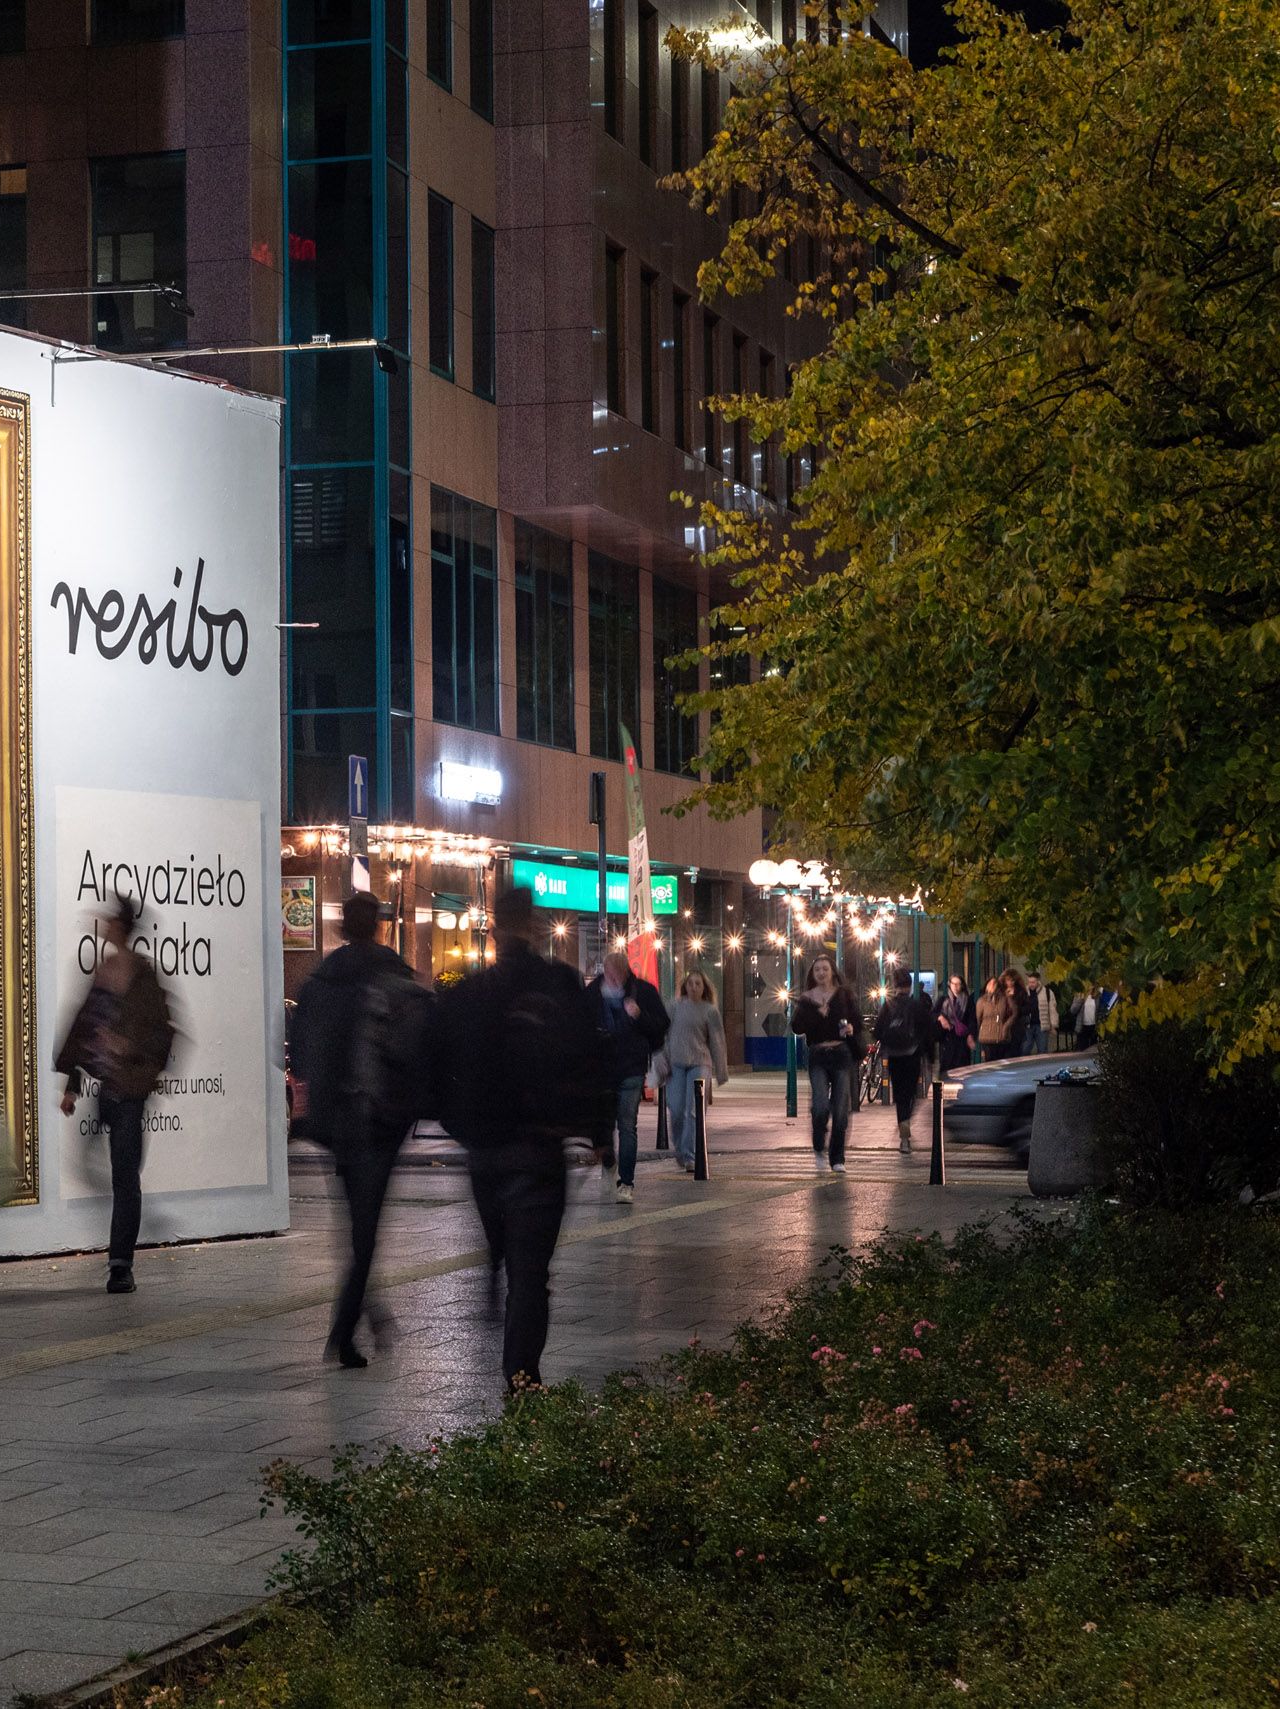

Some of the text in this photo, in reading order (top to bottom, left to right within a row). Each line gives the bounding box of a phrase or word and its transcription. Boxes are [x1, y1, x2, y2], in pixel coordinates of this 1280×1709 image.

[50, 556, 249, 677] resibo
[76, 849, 246, 919] Arcydzieło
[77, 918, 120, 976] d
[190, 1073, 226, 1097] unosi,
